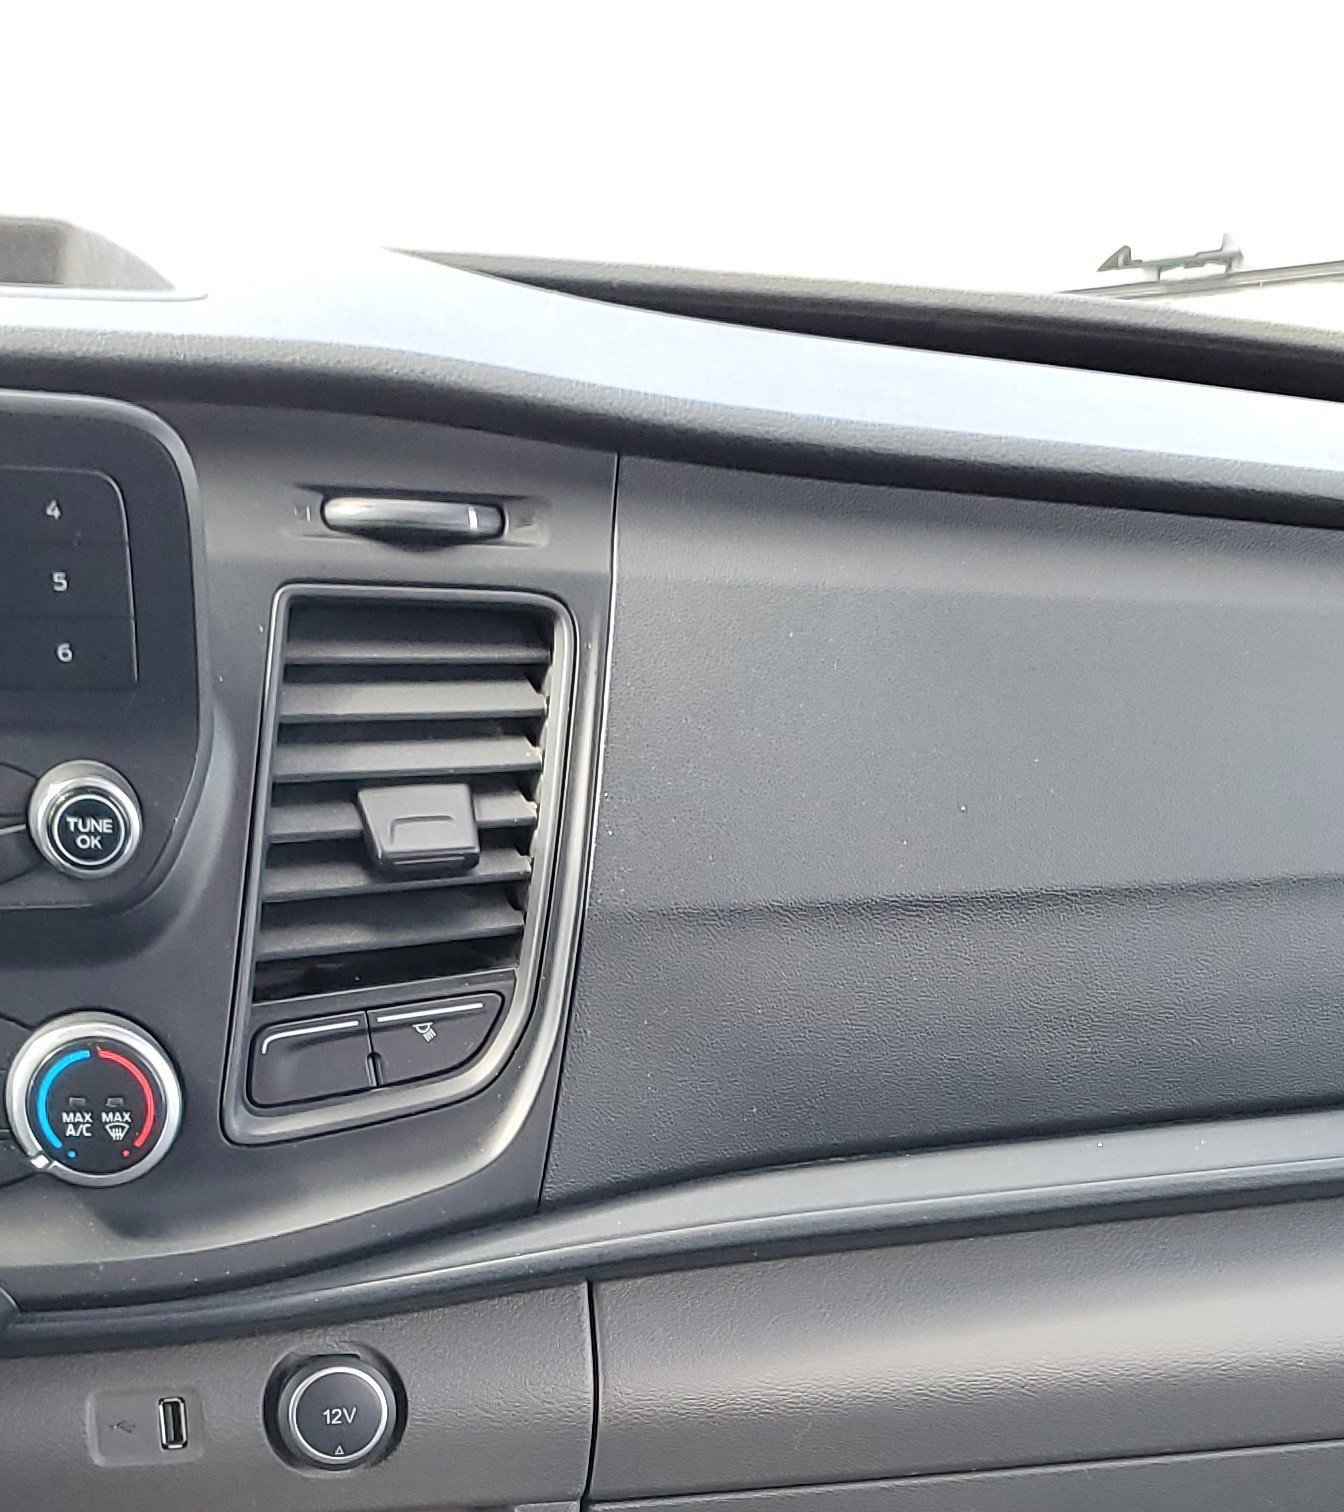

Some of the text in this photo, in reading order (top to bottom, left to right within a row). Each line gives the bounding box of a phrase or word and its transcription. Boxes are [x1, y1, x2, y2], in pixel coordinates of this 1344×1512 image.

[45, 500, 61, 520] 4
[51, 571, 68, 592] 5
[56, 642, 73, 664] 6
[65, 816, 113, 834] TUNE
[75, 835, 103, 851] OK
[62, 1111, 93, 1124] MAX
[101, 1111, 131, 1124] MAX
[66, 1123, 93, 1137] A/C
[322, 1406, 357, 1426] 12V
